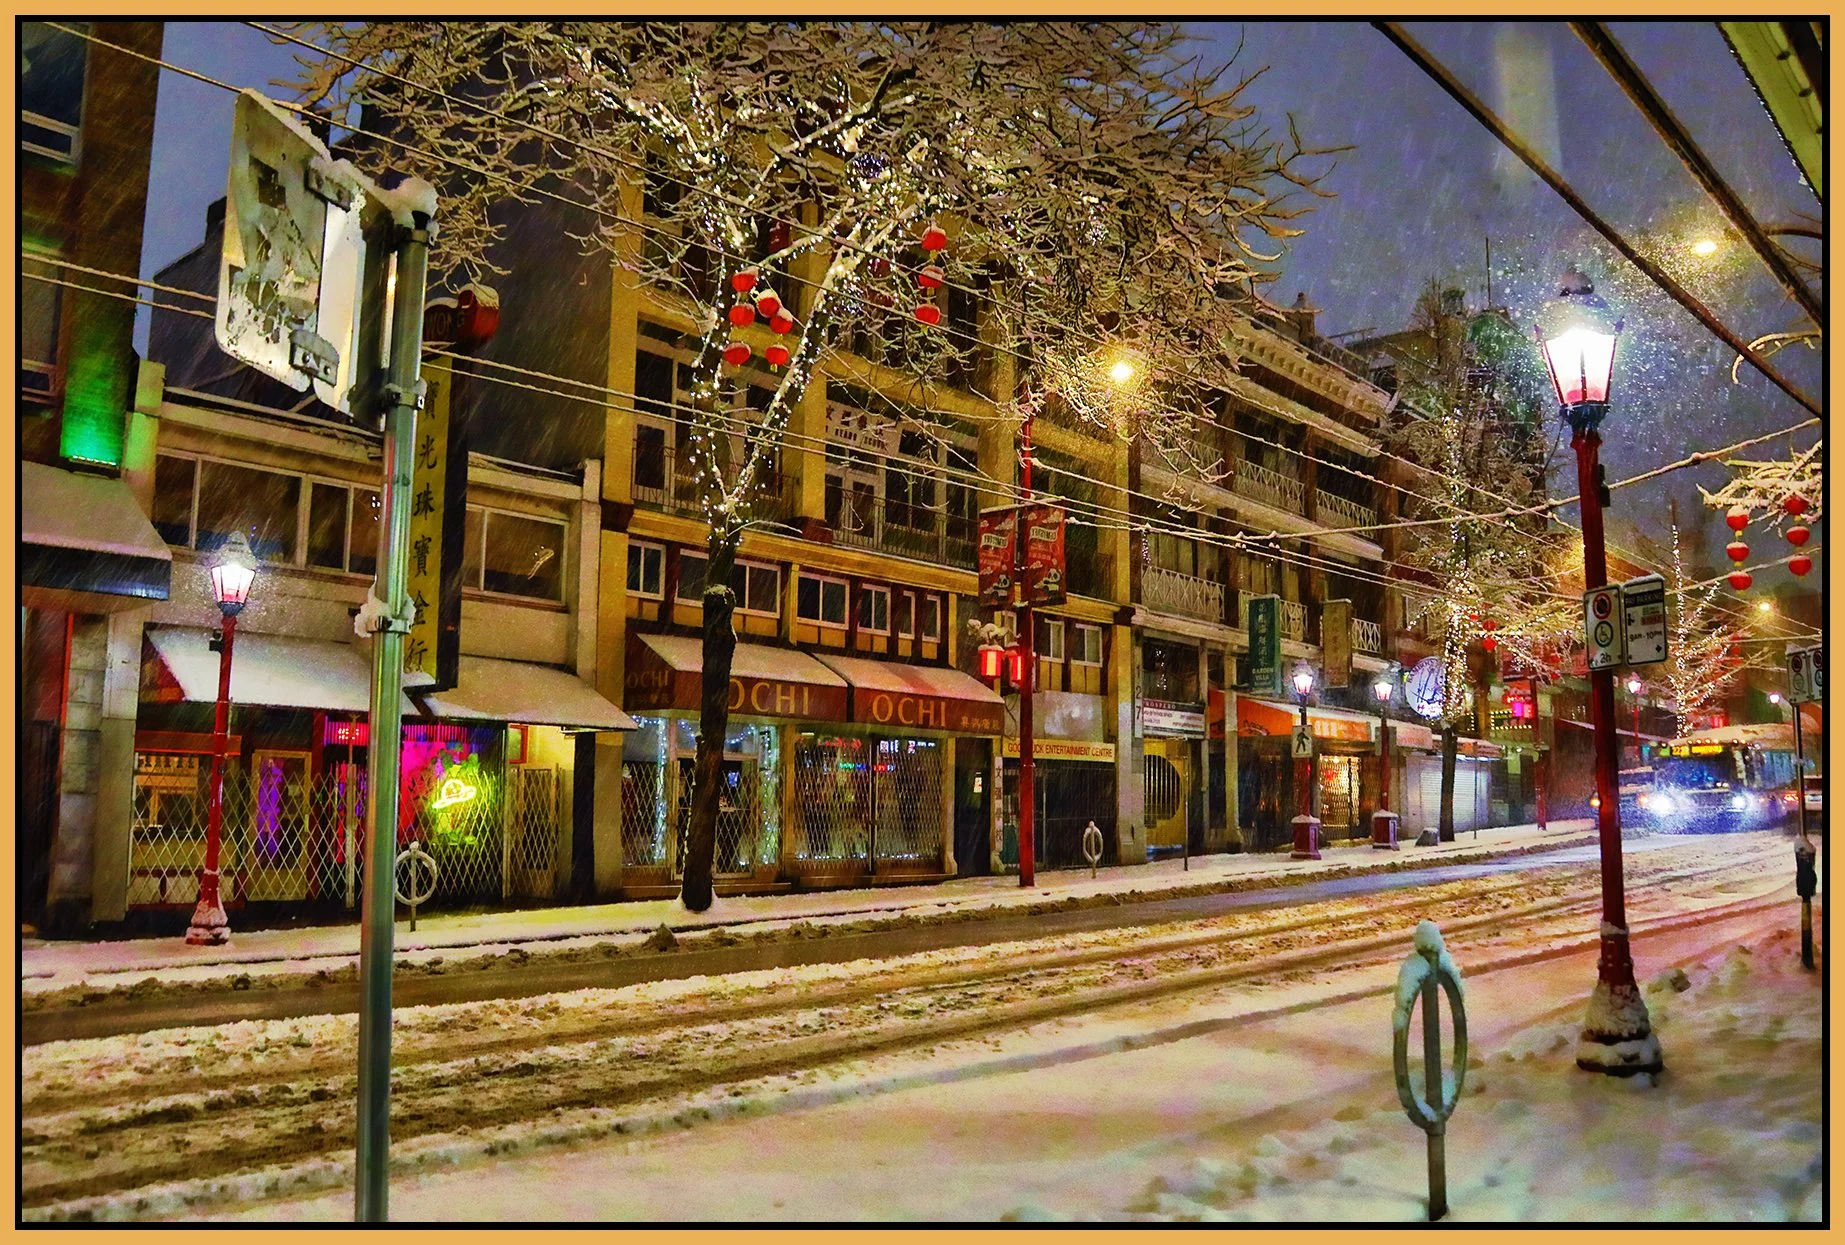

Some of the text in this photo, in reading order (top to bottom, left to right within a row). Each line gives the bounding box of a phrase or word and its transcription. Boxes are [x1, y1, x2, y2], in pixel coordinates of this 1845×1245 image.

[627, 670, 668, 688] OCHI
[872, 694, 946, 727] OCHI
[1032, 743, 1044, 754] UCK
[1045, 745, 1090, 755] ENTERTAINMENT
[1091, 747, 1113, 758] CENTRE
